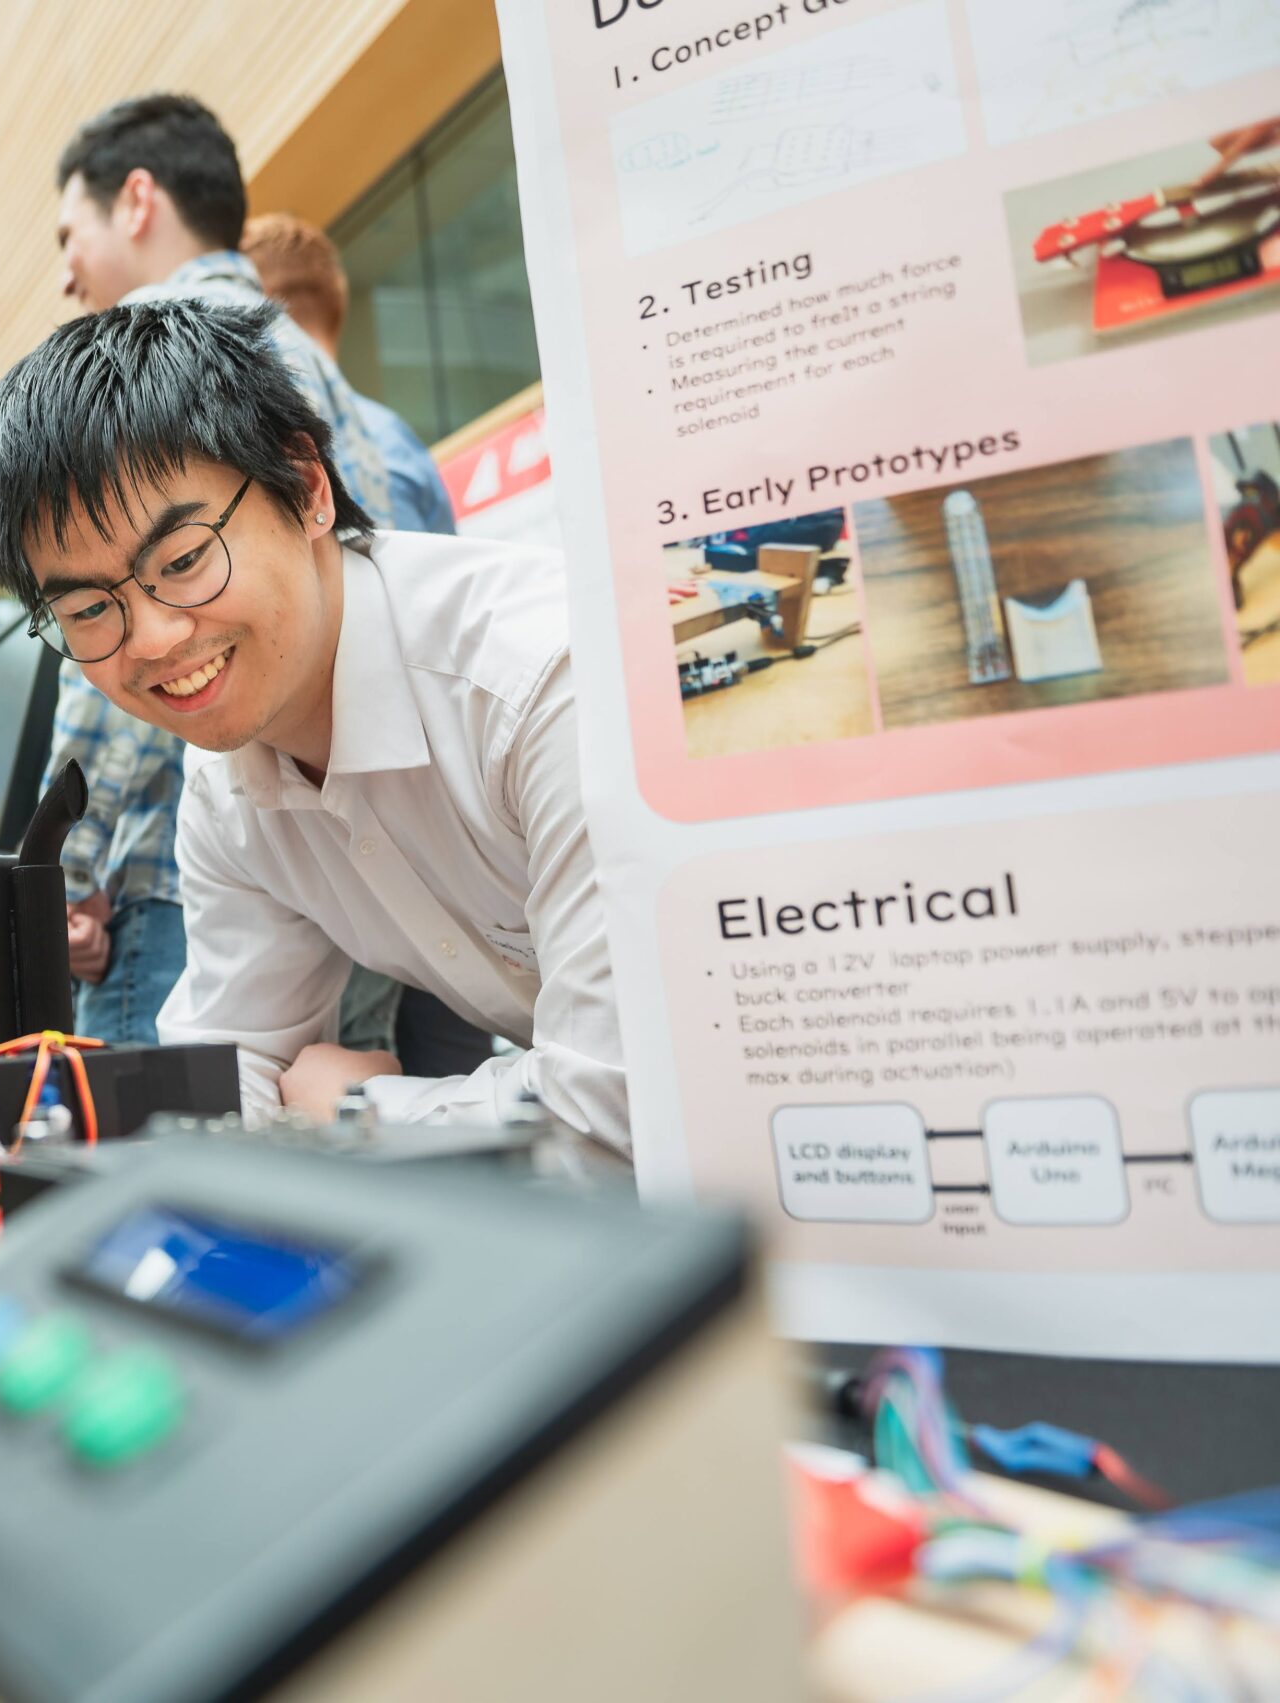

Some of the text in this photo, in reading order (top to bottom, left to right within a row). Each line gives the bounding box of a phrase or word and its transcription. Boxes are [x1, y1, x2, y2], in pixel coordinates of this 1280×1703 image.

[651, 3, 790, 72] Concept
[637, 252, 814, 321] 2. Testing
[665, 253, 963, 348] Determined how much force
[668, 355, 686, 370] is
[691, 329, 777, 364] required
[783, 321, 806, 338] to
[868, 302, 883, 316] a
[889, 280, 957, 308] string
[671, 318, 906, 392] Measuring the current
[673, 346, 895, 415] requirement for each
[676, 404, 761, 438] solenoid
[657, 429, 1022, 525] 3. Early Prototypes
[717, 873, 1018, 940] Electrical
[730, 960, 797, 982] Using
[803, 960, 819, 976] a
[828, 952, 875, 973] 12V
[889, 947, 975, 971] laptop
[981, 942, 1059, 964] power
[734, 981, 911, 1006] buck converter
[738, 1012, 795, 1034] Each
[801, 1006, 902, 1031] solenoid
[909, 1001, 1017, 1025] requires
[1098, 991, 1151, 1012] and
[1206, 986, 1240, 1006] to
[743, 1038, 851, 1060] solenoids
[857, 1035, 880, 1053] in
[888, 1031, 984, 1056] parallel
[992, 1026, 1068, 1049] being
[1075, 1018, 1203, 1047] operated
[1212, 1014, 1241, 1036] at
[746, 1057, 1017, 1089] max during actuation)
[789, 1142, 912, 1164] LCD display
[793, 1167, 916, 1186] and buttons
